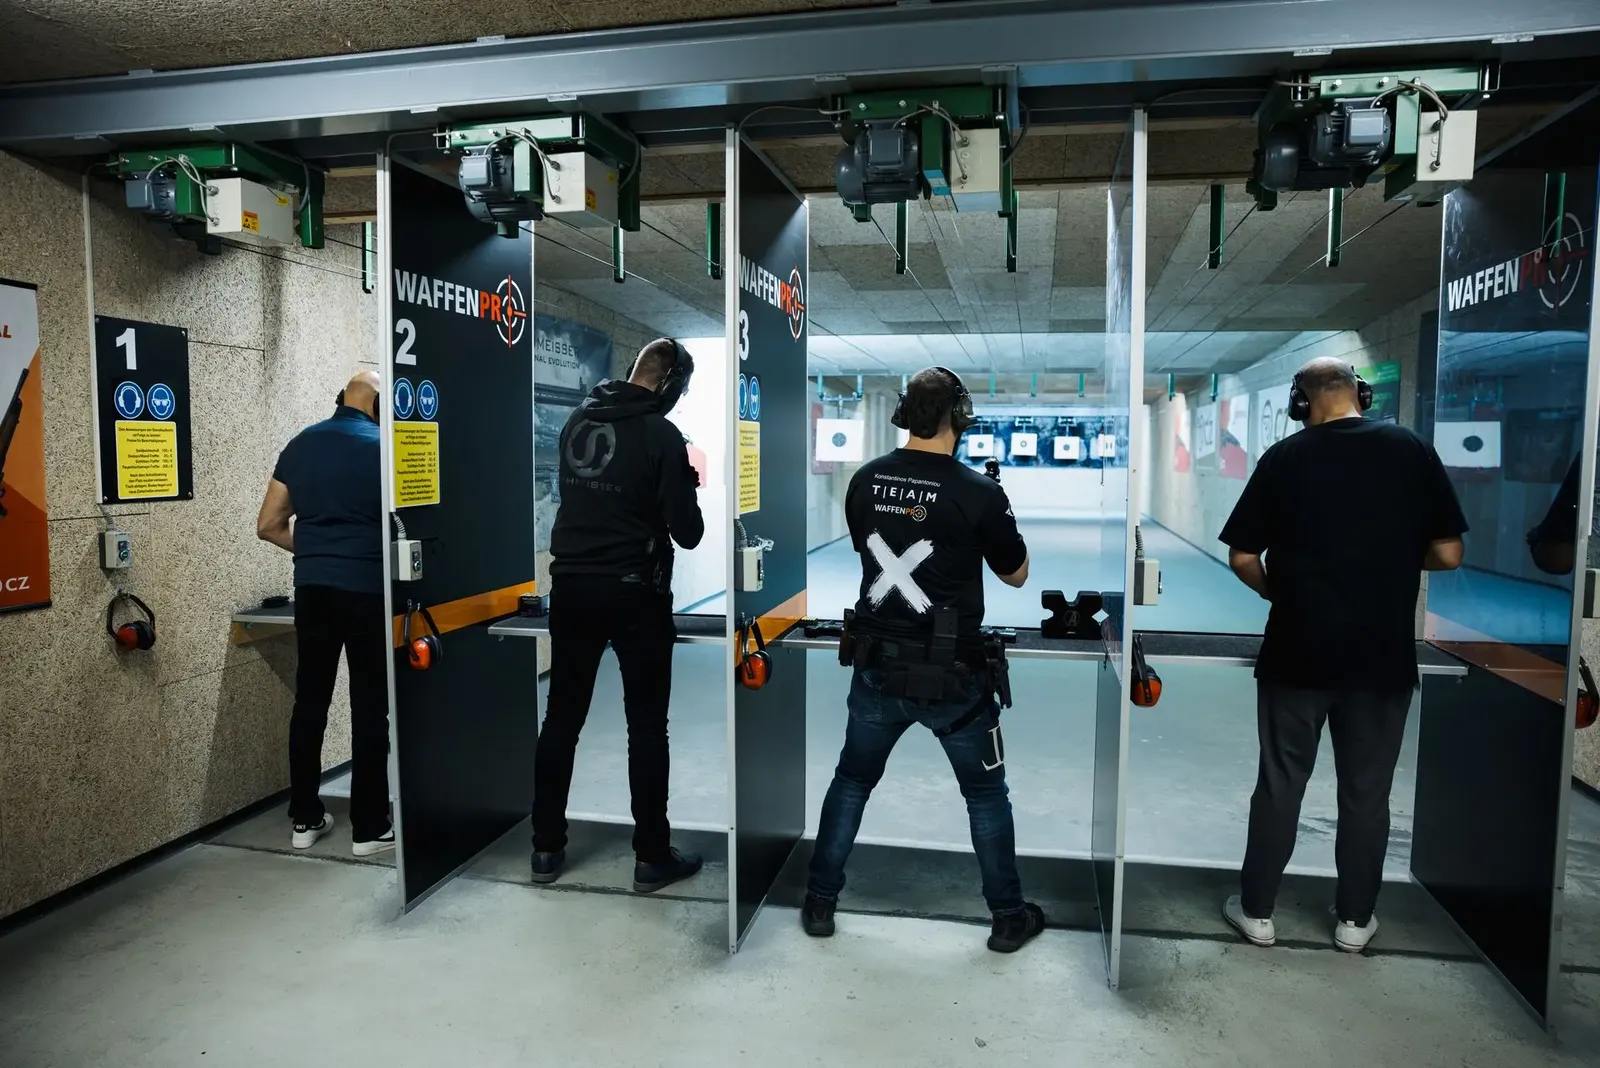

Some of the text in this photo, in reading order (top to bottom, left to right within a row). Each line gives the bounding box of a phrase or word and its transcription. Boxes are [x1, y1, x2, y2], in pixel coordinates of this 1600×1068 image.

[0, 324, 12, 339] L
[395, 318, 417, 366] 2
[739, 309, 750, 361] 3
[115, 327, 137, 370] 1
[874, 473, 907, 483] Konstantinos
[5, 575, 30, 592] CZ
